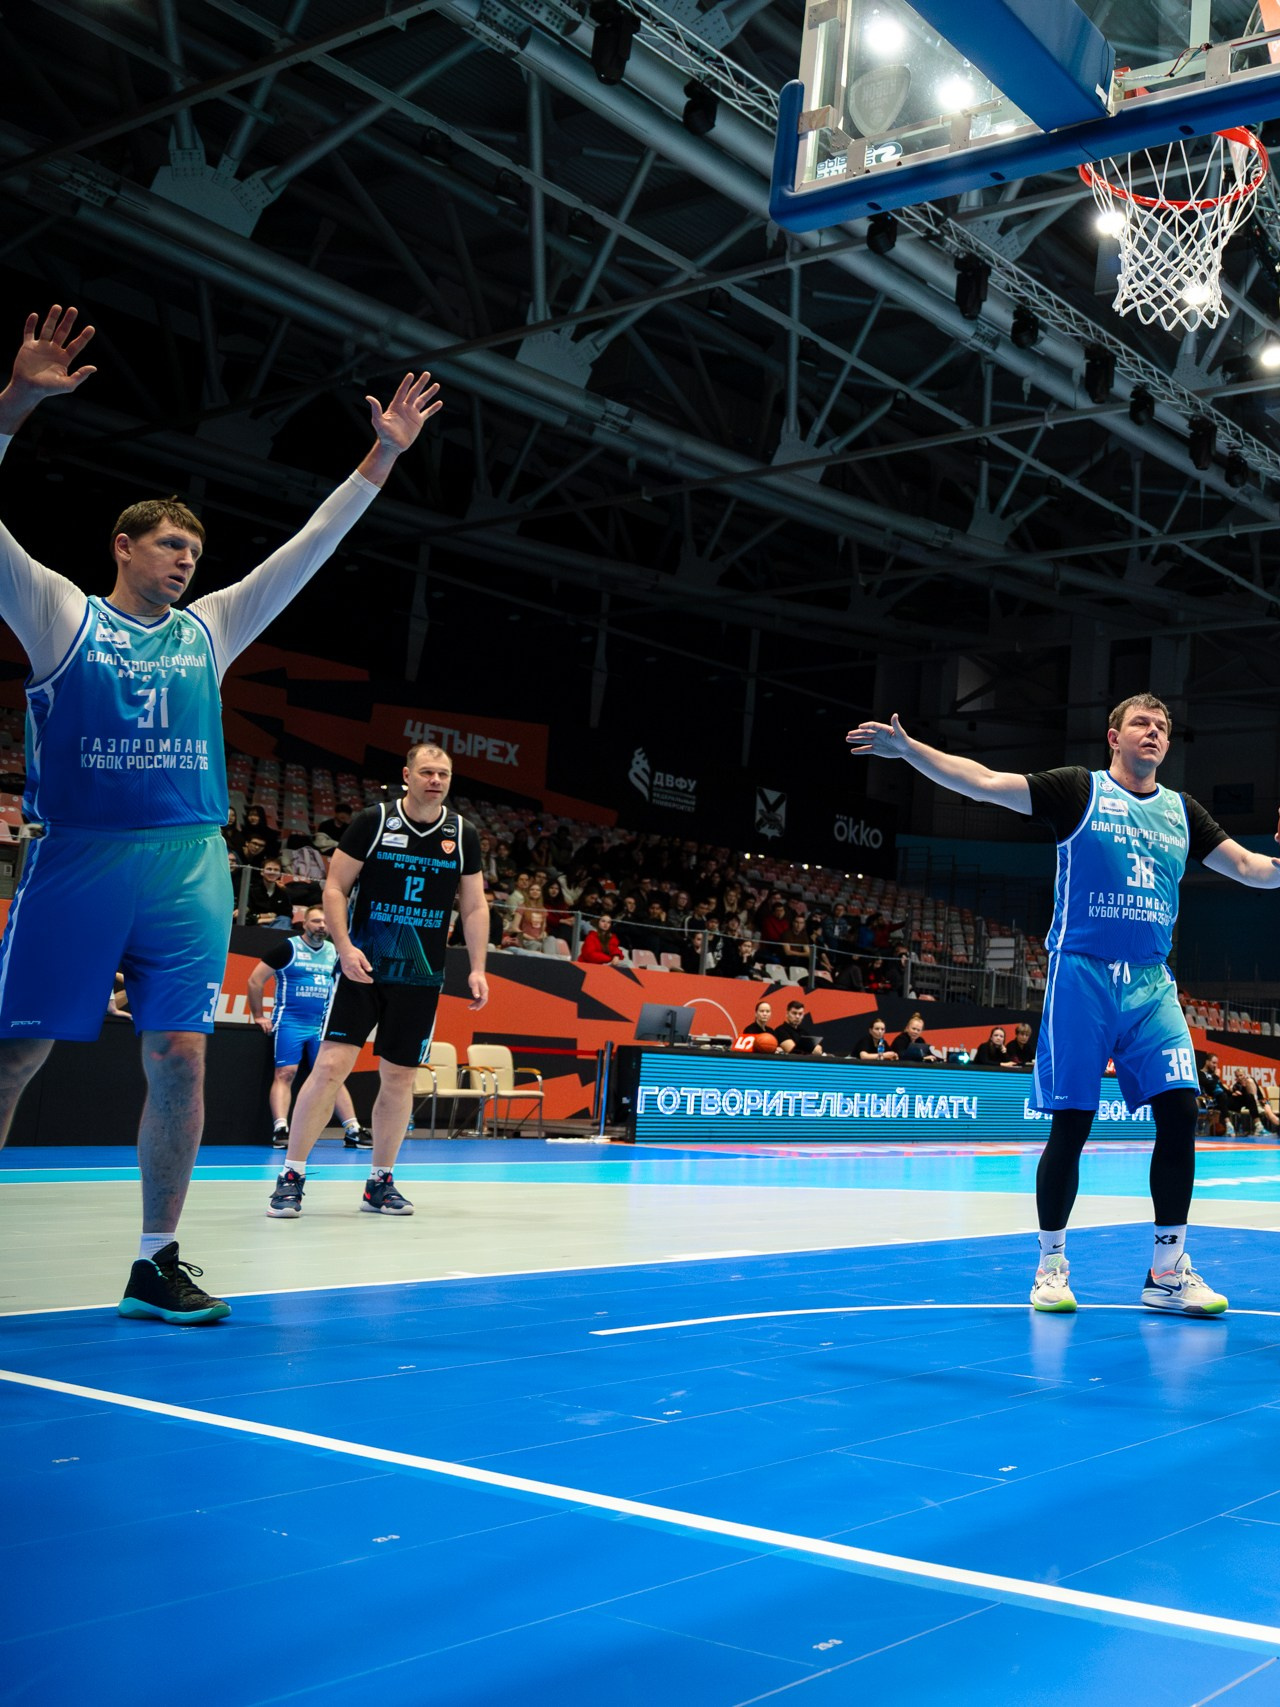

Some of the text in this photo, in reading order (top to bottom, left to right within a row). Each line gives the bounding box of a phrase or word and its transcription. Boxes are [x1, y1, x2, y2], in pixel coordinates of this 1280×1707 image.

[137, 688, 169, 728] 31
[81, 737, 208, 755] ГАЗПРОМБАНК
[403, 719, 519, 767] ЧЕТЫРЕХ
[81, 754, 208, 771] КУБОК РОССИИ 25/26
[652, 770, 698, 792] ДВФУ
[1091, 820, 1187, 850] БЛАГОТВОРИТЕЛЬНЫЙ
[1113, 835, 1169, 853] МАТЧ
[377, 851, 458, 870] БЛАГОТВОРИТЕЛЬНЫЙ
[394, 862, 440, 875] МАТЧ
[1126, 853, 1155, 890] 38
[404, 876, 426, 903] 12
[1088, 892, 1173, 914] ГАЗПРОМБ
[1088, 905, 1122, 919] КУБОК
[1161, 1048, 1194, 1082] 38
[915, 1096, 978, 1121] МАТЧ
[1155, 1234, 1179, 1245] X3
